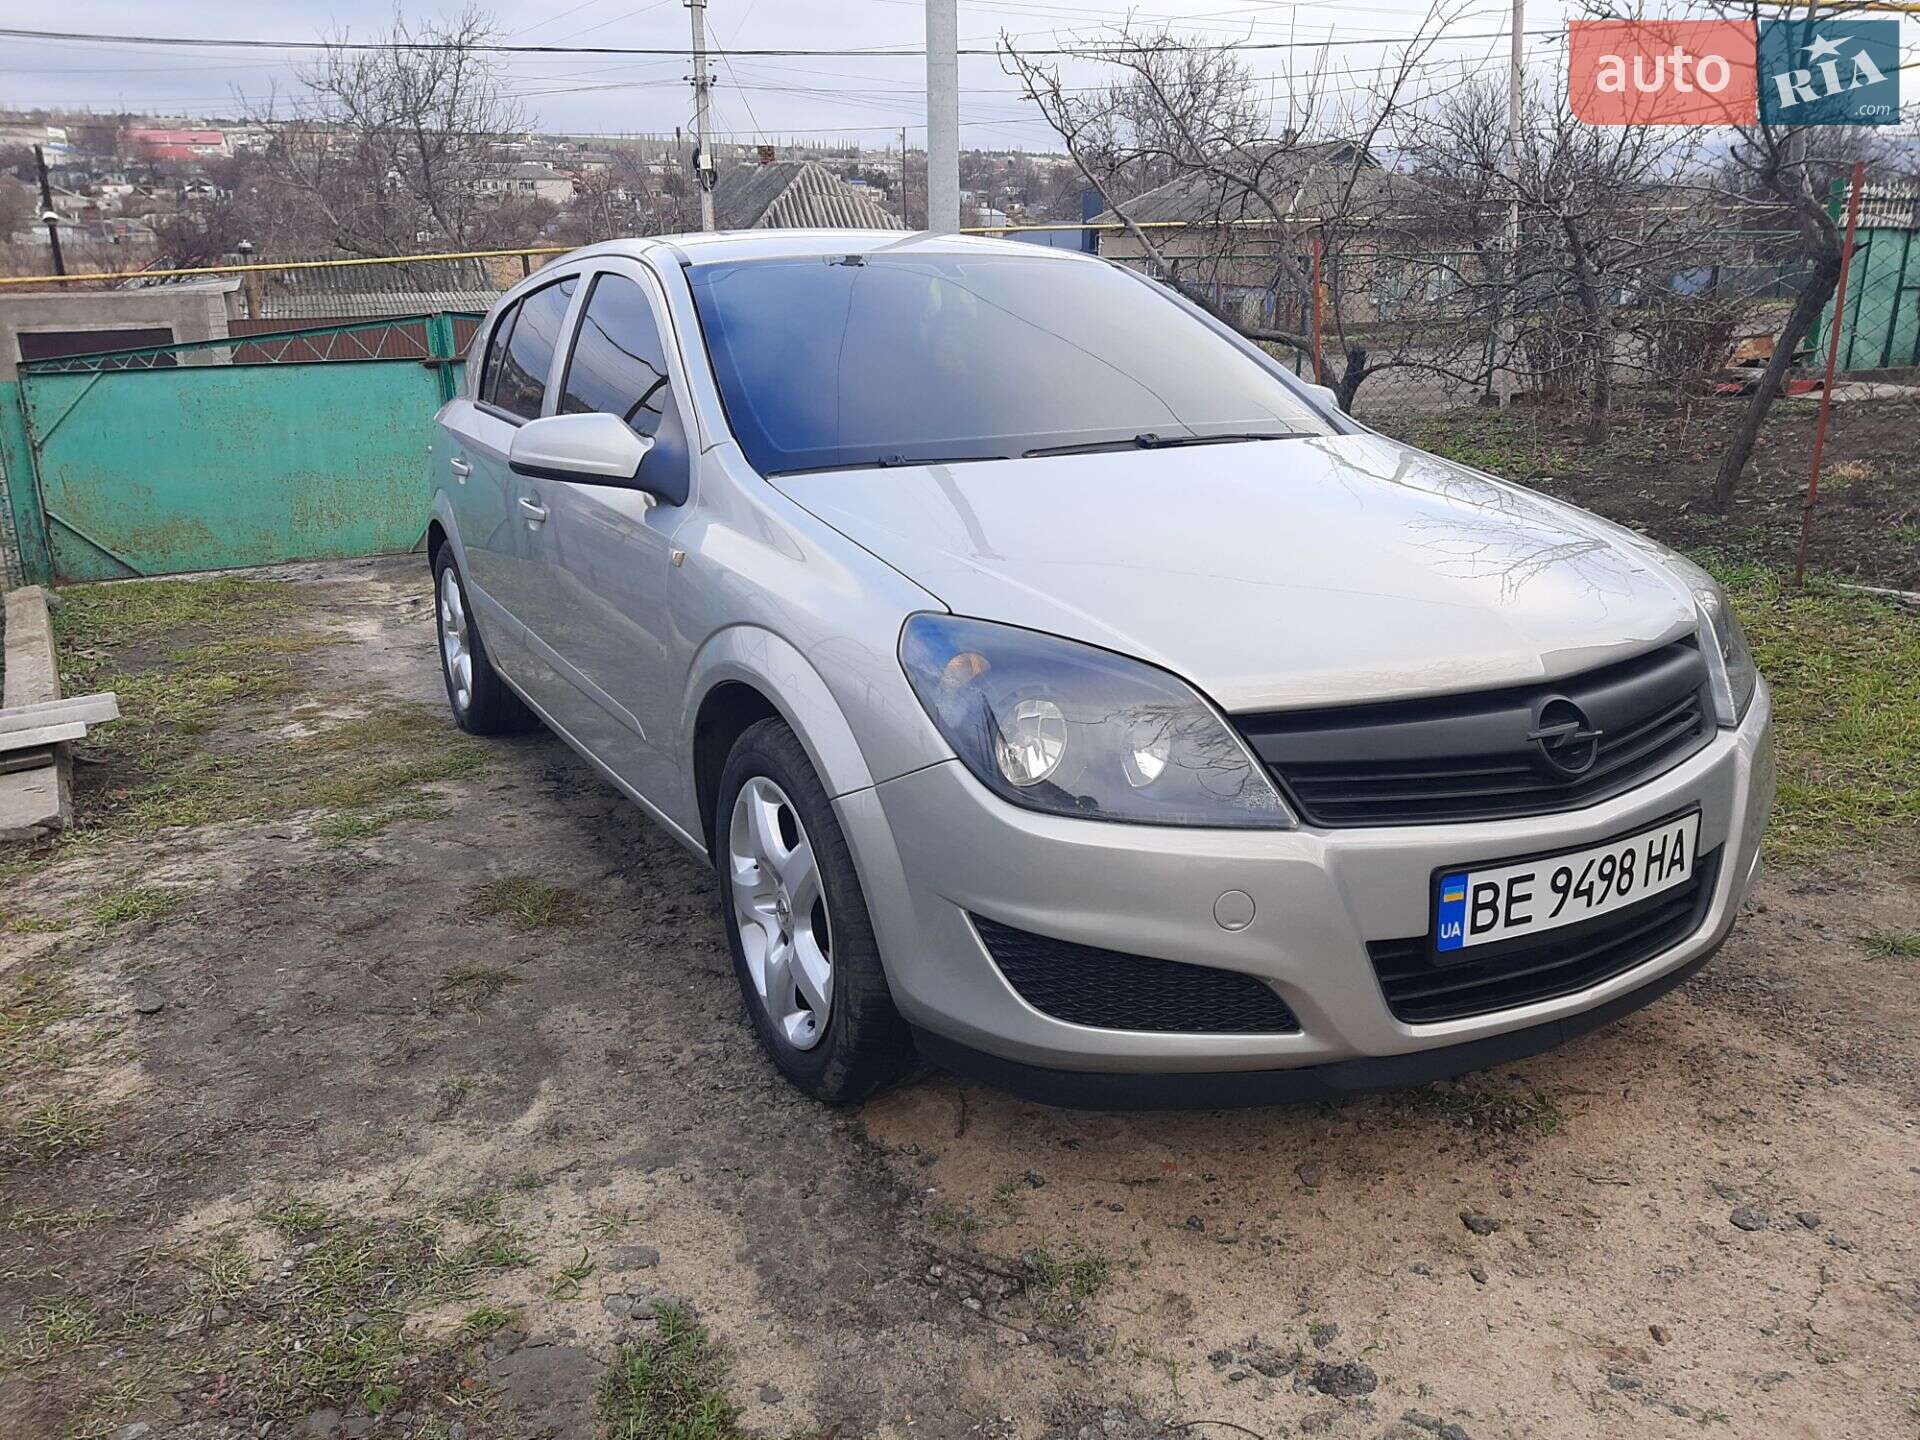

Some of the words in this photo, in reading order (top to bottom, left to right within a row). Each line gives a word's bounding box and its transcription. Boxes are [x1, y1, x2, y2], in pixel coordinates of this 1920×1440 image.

[1469, 873, 1536, 935] BE
[1548, 847, 1636, 918] 9498
[1643, 828, 1685, 888] HA
[1440, 921, 1462, 939] UA
